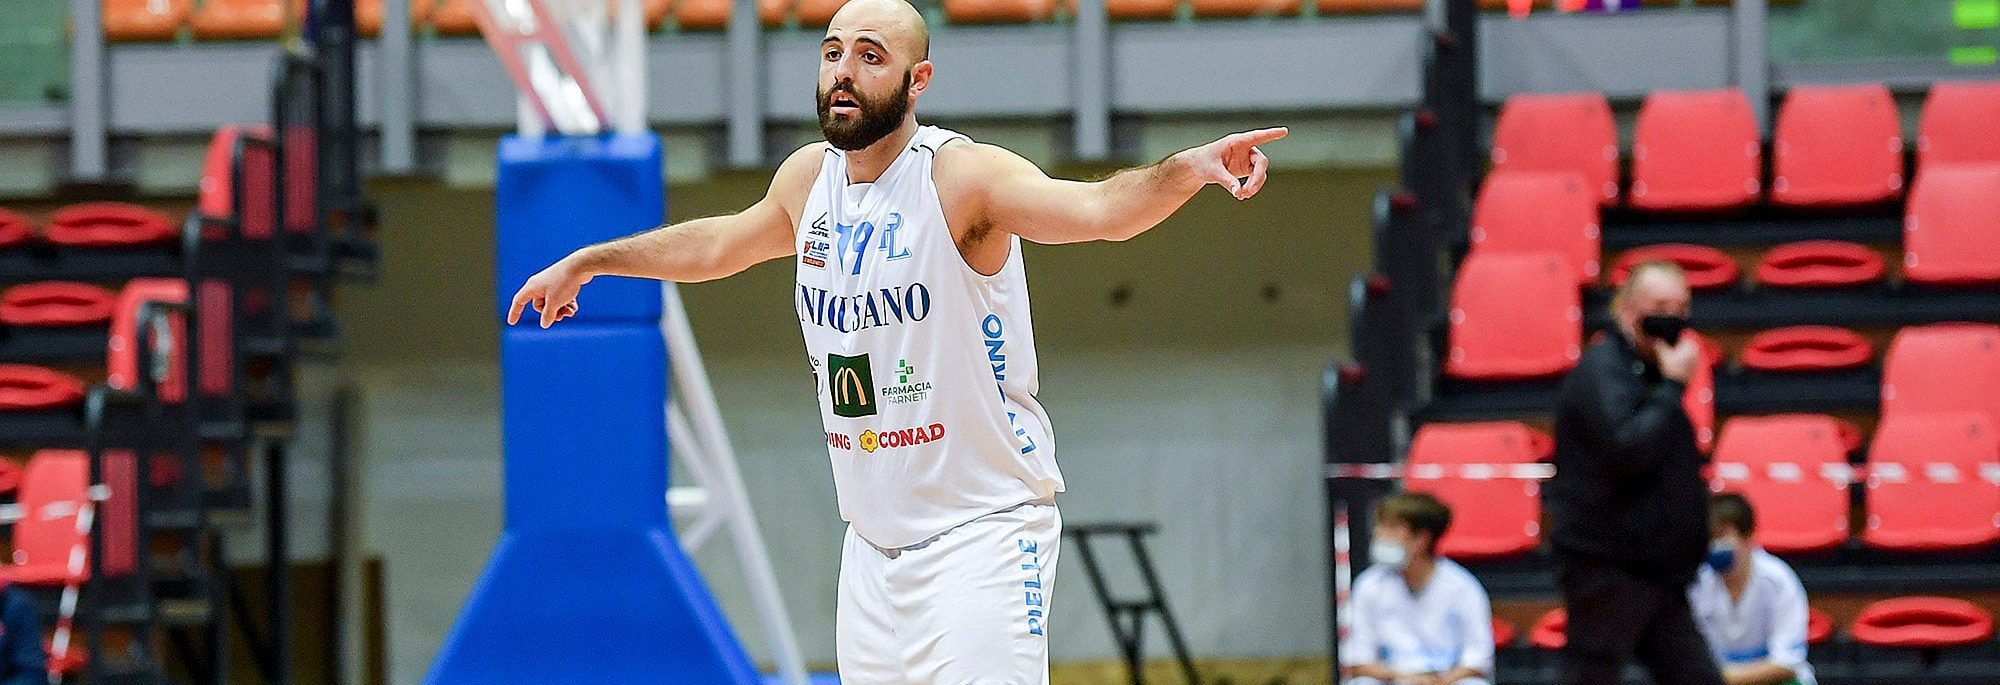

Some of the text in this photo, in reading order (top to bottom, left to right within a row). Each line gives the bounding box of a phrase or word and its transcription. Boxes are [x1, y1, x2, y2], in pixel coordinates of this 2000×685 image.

[835, 221, 875, 275] 79
[797, 282, 931, 333] NICUSANO
[881, 381, 932, 396] FARMACIA
[888, 391, 927, 405] FARNETI
[828, 431, 851, 450] ING
[878, 422, 945, 449] CONAD
[1018, 538, 1044, 636] PIELLE
